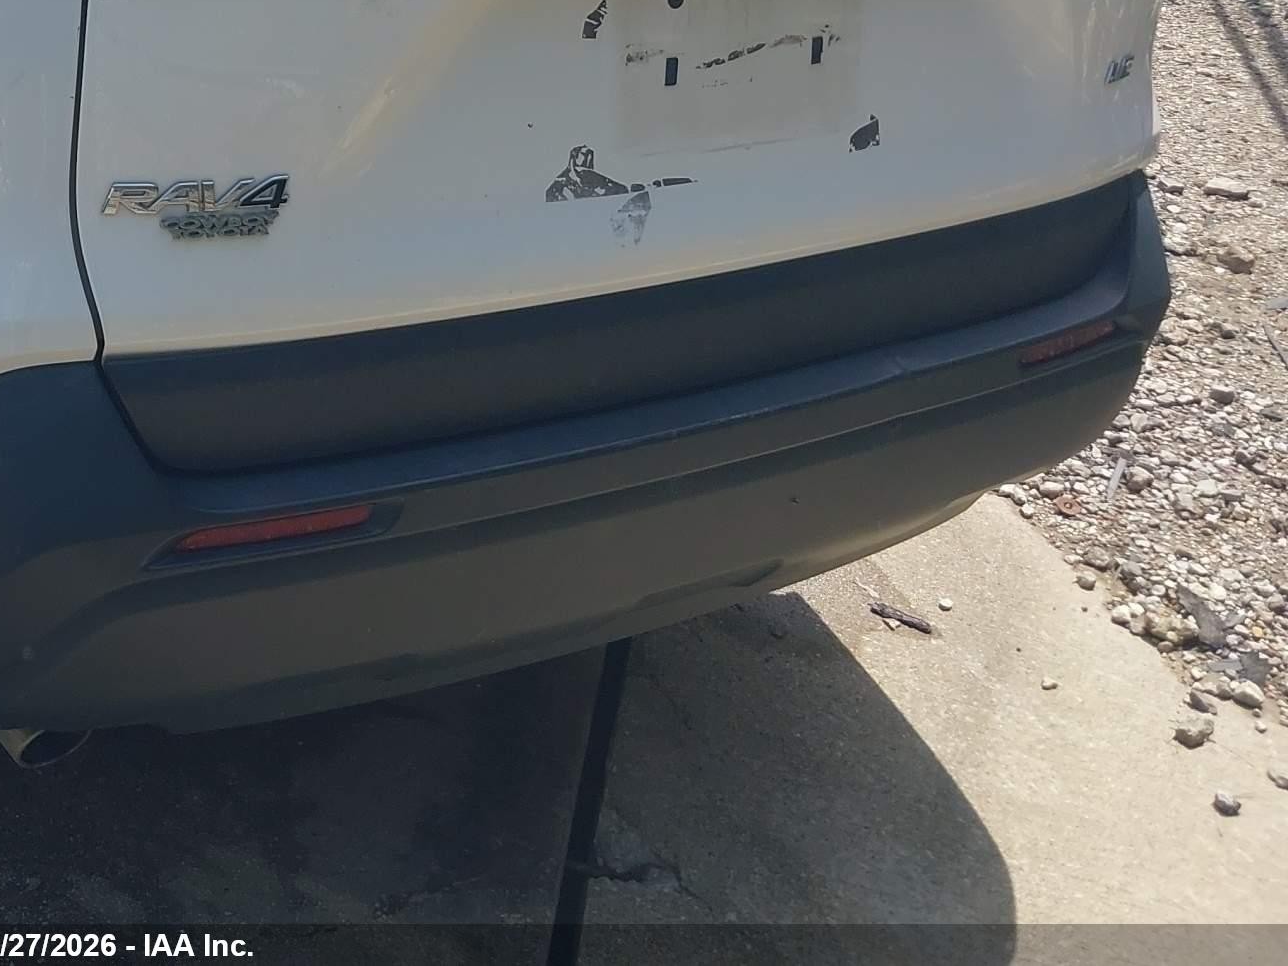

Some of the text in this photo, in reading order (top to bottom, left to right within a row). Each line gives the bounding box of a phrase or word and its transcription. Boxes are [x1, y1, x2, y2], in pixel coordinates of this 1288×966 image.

[101, 174, 289, 215] RAV4
[161, 209, 279, 229] COWBOY
[172, 224, 269, 240] TOYOTA
